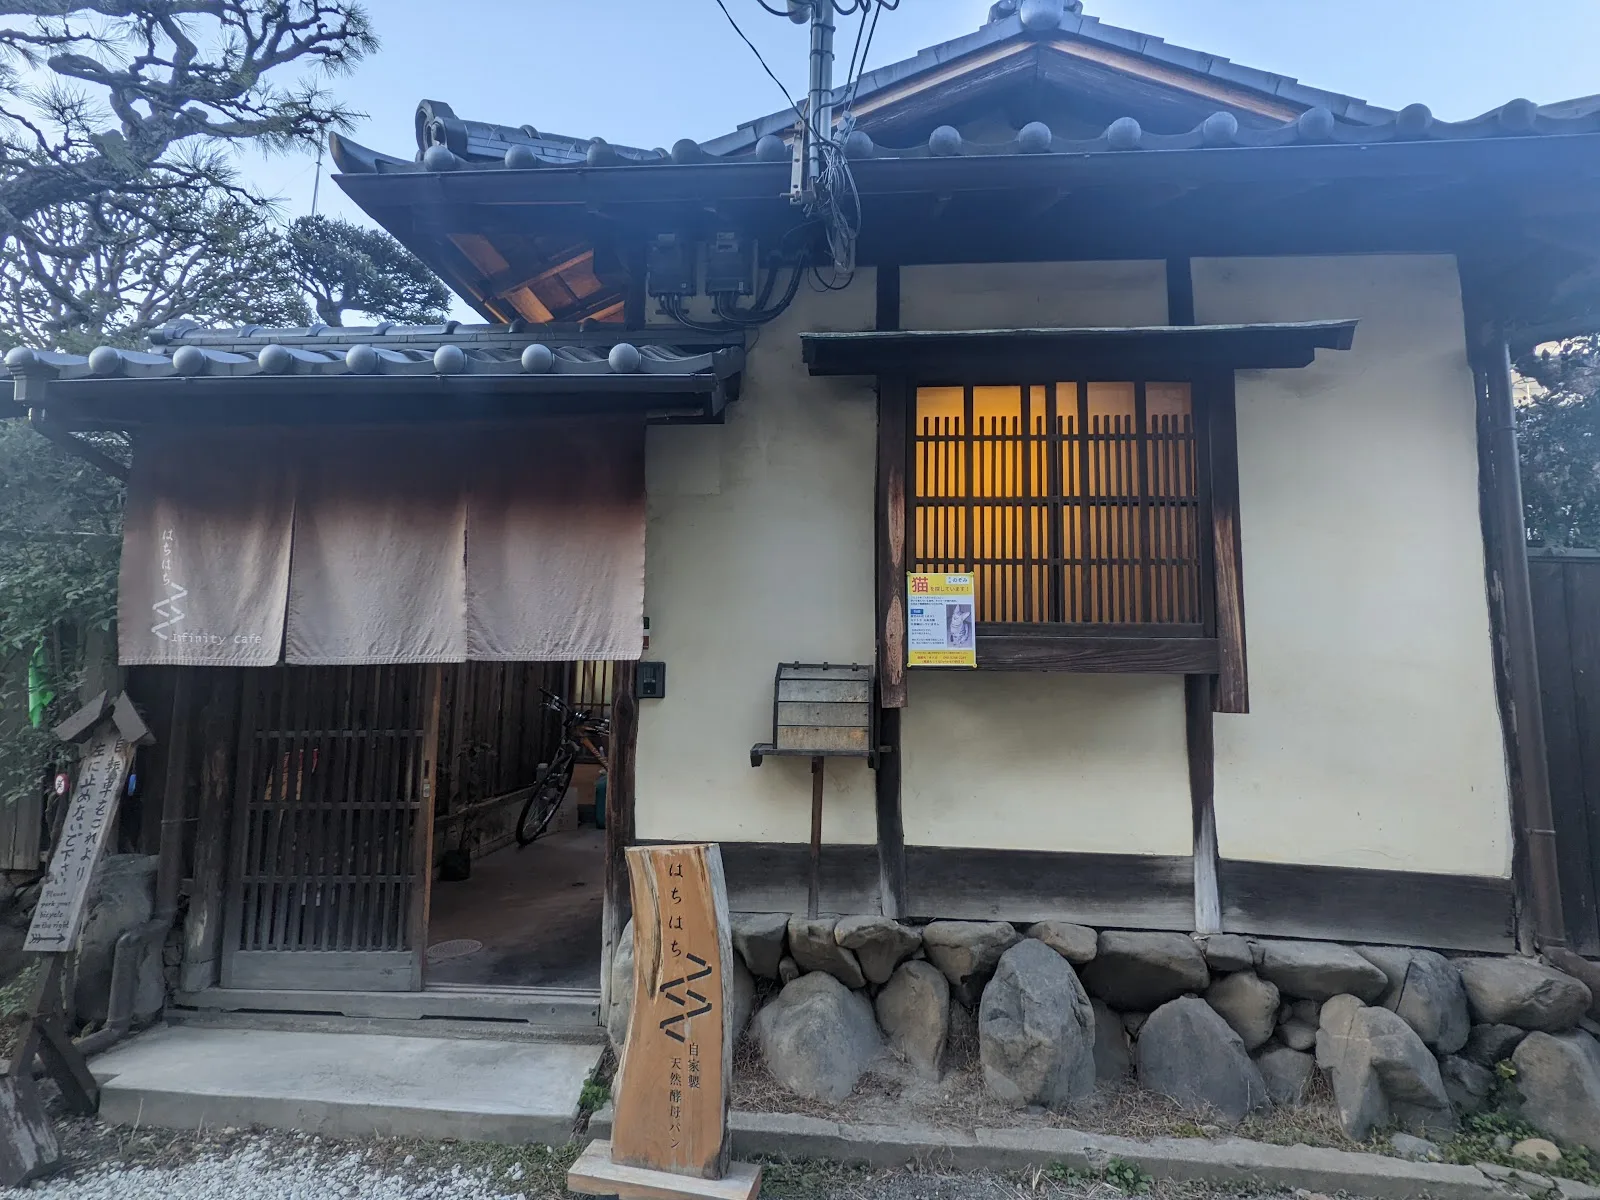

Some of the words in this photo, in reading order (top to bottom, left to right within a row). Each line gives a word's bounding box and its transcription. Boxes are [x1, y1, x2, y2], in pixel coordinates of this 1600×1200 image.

[161, 529, 173, 586] はちはち
[912, 576, 928, 593] 猫
[172, 633, 226, 646] Infinity
[54, 742, 105, 885] 左に止めないで下さい
[669, 862, 684, 958] はちはち
[688, 1042, 701, 1089] 自家製
[669, 1057, 682, 1149] 天然酵母パン
